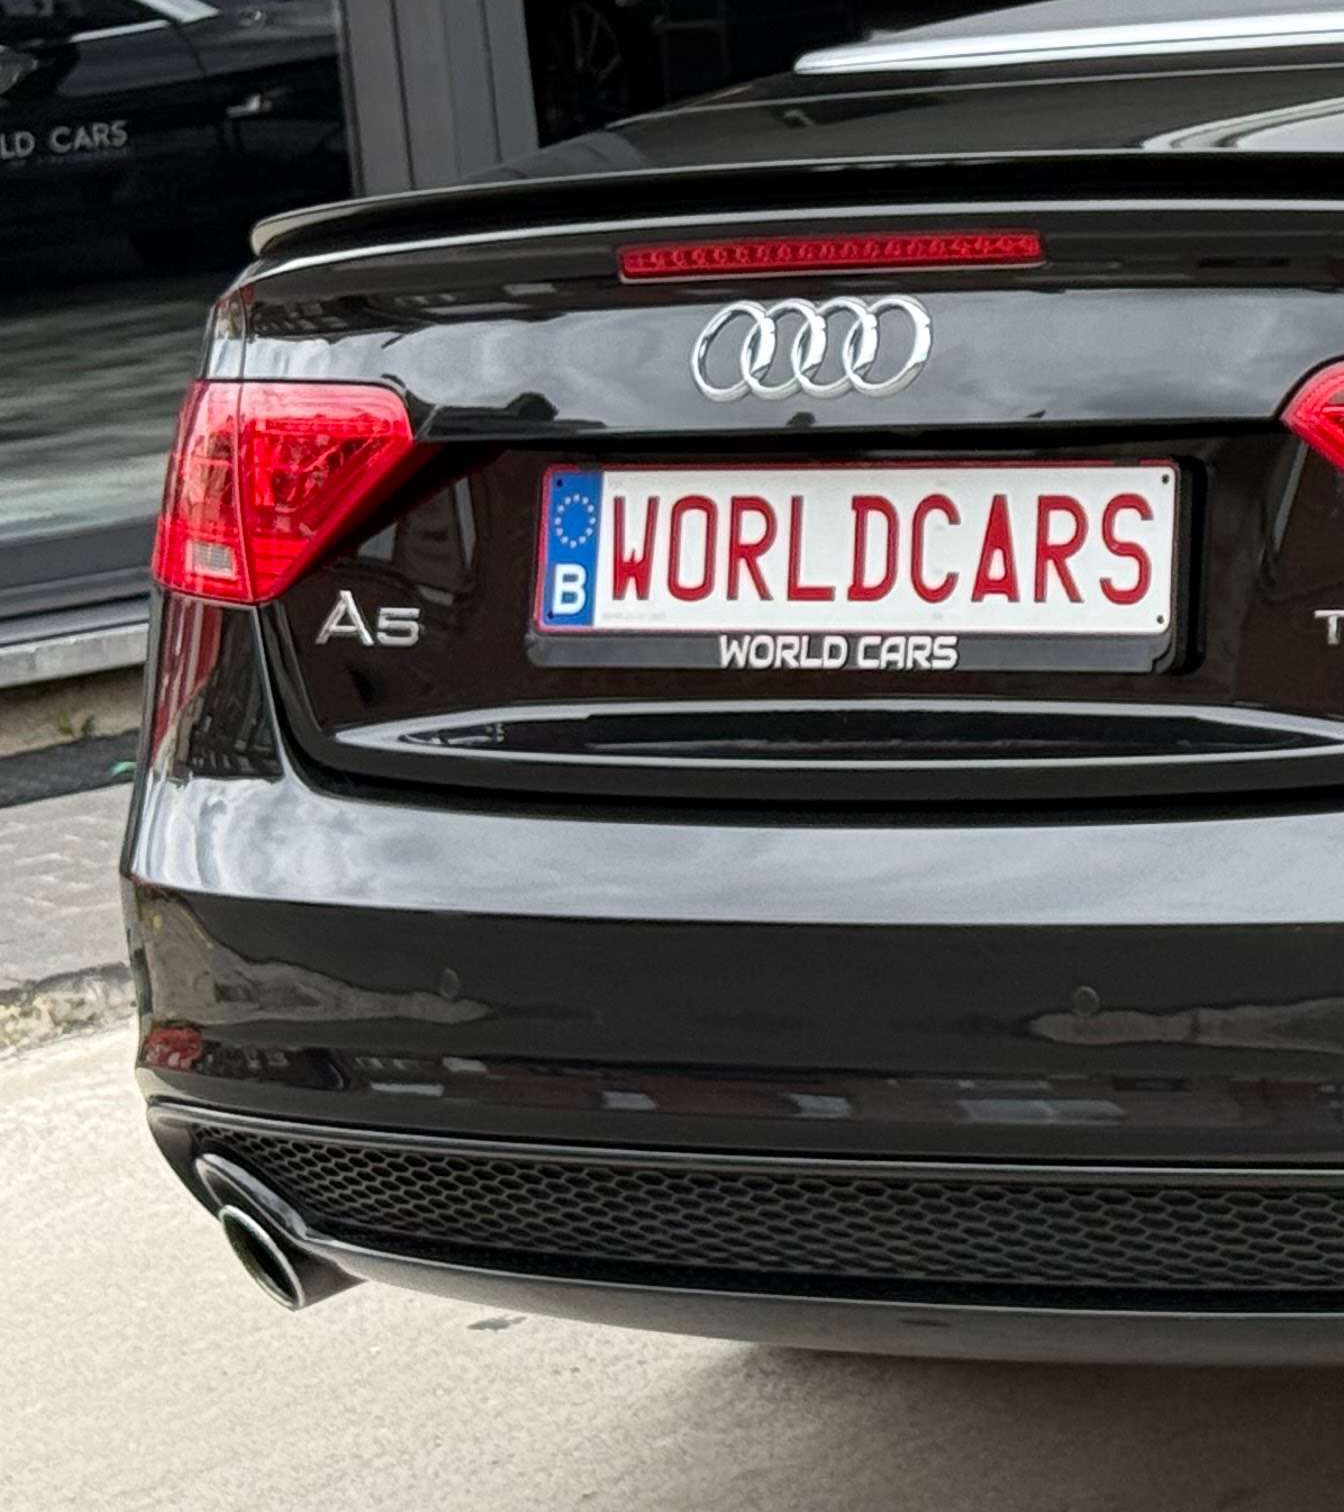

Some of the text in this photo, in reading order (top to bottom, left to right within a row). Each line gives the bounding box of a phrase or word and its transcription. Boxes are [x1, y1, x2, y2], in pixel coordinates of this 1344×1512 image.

[49, 119, 129, 154] CARS
[611, 492, 1154, 605] WORLDCARS
[551, 563, 588, 616] B
[314, 588, 421, 647] A5
[718, 633, 960, 671] WORLD CARS
